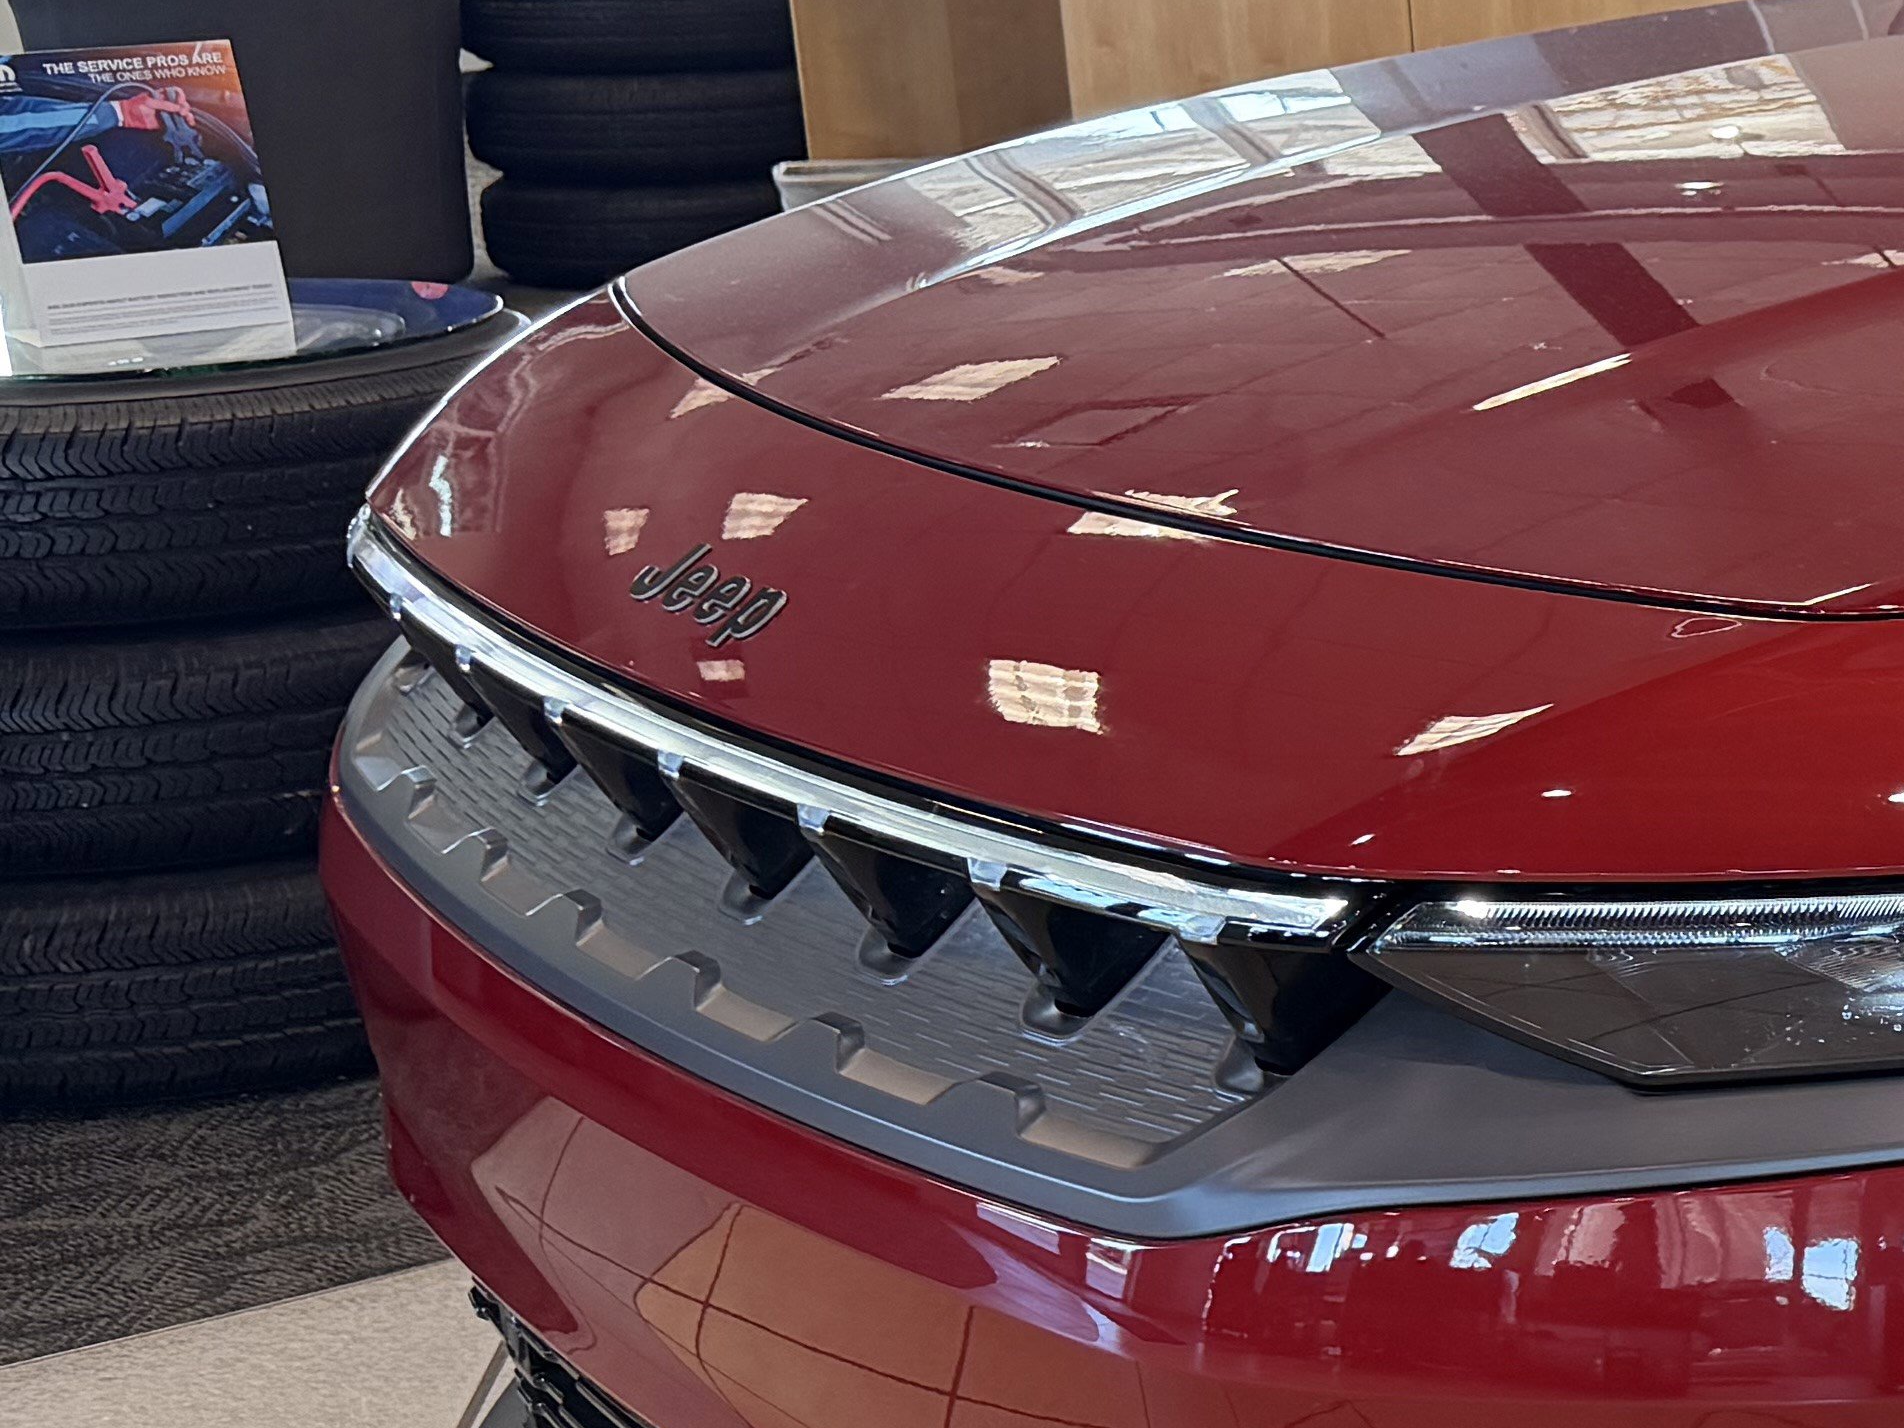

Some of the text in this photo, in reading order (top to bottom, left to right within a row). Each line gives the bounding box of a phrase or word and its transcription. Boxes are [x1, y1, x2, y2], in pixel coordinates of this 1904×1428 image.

[42, 52, 223, 75] THE SERVICE PROS ARE
[88, 64, 226, 83] THE ONES WHO KNOW
[630, 543, 788, 648] Jeep
